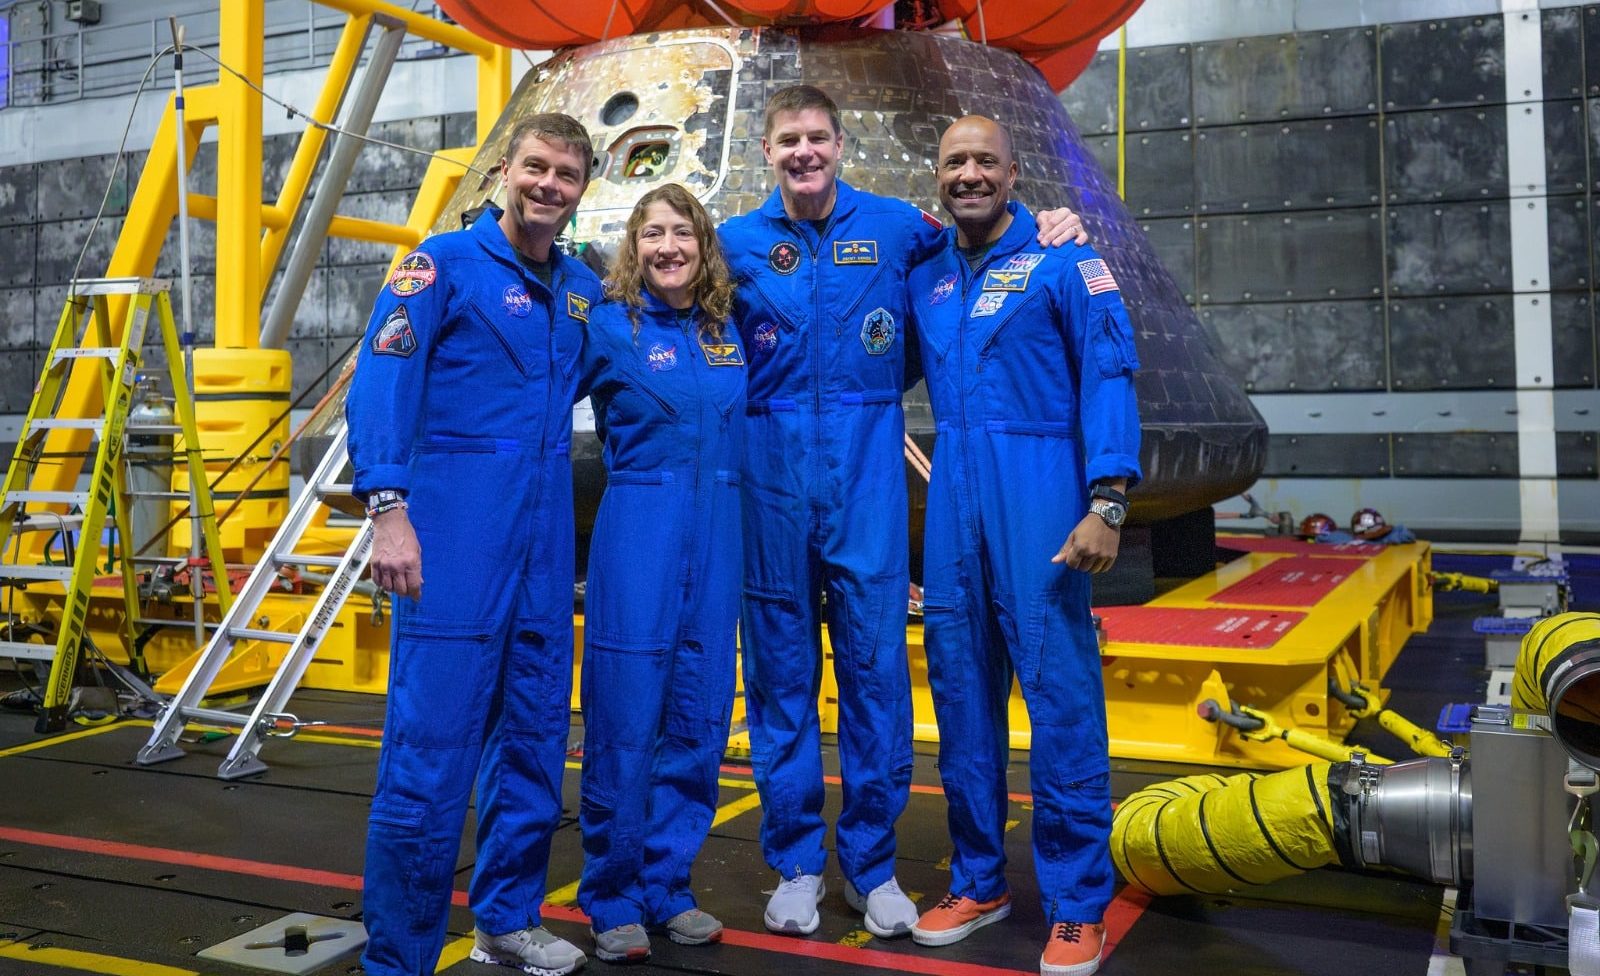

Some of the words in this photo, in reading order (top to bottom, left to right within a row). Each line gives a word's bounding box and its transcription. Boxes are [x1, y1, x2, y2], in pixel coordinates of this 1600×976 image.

[505, 295, 531, 305] NASA
[649, 352, 676, 362] NASA
[58, 651, 73, 698] WERNER
